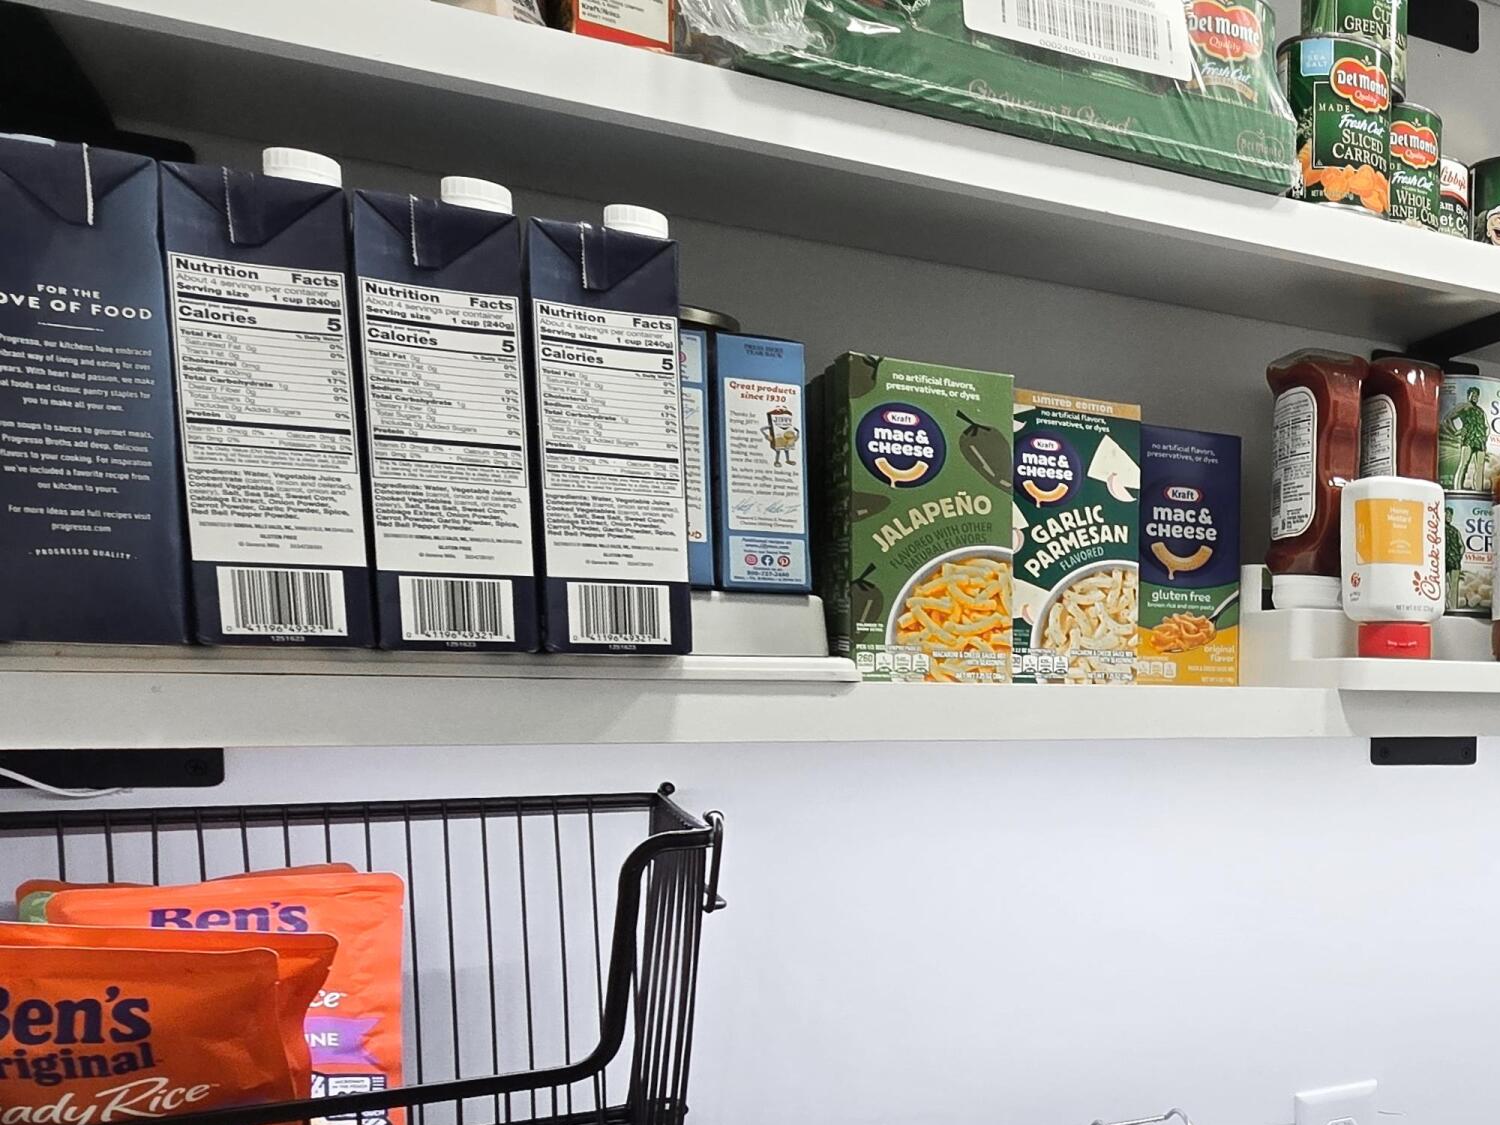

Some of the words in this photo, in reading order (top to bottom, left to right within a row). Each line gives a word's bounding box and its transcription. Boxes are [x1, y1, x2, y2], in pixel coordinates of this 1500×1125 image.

[1216, 20, 1260, 43] Monte
[1344, 16, 1389, 33] GREEN
[1201, 62, 1231, 79] Fresh
[1231, 69, 1251, 84] Cut
[1337, 70, 1358, 85] Del
[1359, 74, 1387, 98] Monte
[1318, 103, 1350, 113] MADE
[1339, 114, 1368, 130] Fresh
[1368, 123, 1385, 137] Cut
[1342, 130, 1383, 154] SLICED
[1390, 132, 1408, 145] Del
[1409, 134, 1437, 155] Monte
[1333, 144, 1388, 172] CARROTS
[1397, 189, 1432, 210] WHOLE
[176, 258, 259, 280] Nutrition
[291, 273, 339, 288] Facts
[37, 284, 67, 295] FOR
[72, 288, 100, 299] THE
[365, 282, 440, 304] Nutrition
[469, 297, 513, 311] Facts
[0, 292, 41, 309] OVE
[50, 299, 81, 313] OF
[91, 303, 152, 320] FOOD
[179, 305, 257, 325] Calories
[327, 318, 342, 332] 5
[368, 328, 438, 346] Calories
[501, 339, 514, 353] 5
[729, 381, 754, 391] Great
[757, 385, 796, 396] products
[886, 381, 948, 398] preservatives,
[949, 388, 958, 397] or
[960, 391, 980, 401] dyes
[892, 372, 903, 381] no
[905, 374, 942, 387] artificial
[945, 379, 975, 392] flavors,
[740, 391, 763, 401] since
[766, 393, 787, 402] 1930
[889, 413, 912, 423] Kraft
[874, 427, 913, 443] mac
[915, 429, 929, 445] &
[1036, 441, 1055, 449] Kraft
[1022, 452, 1056, 466] mac
[1058, 455, 1069, 468] &
[1171, 489, 1195, 500] Kraft
[871, 490, 992, 552] JALAPEÑO
[1031, 504, 1105, 544] GARLIC
[1153, 507, 1196, 522] mac
[1198, 508, 1212, 525] &
[1024, 524, 1128, 578] PARMESAN
[1059, 546, 1105, 570] FLAVORED
[1151, 590, 1183, 604] gluten
[1186, 592, 1211, 603] free
[150, 903, 309, 933] Ben's
[0, 1045, 156, 1086] riginal
[96, 1077, 211, 1122] Rice
